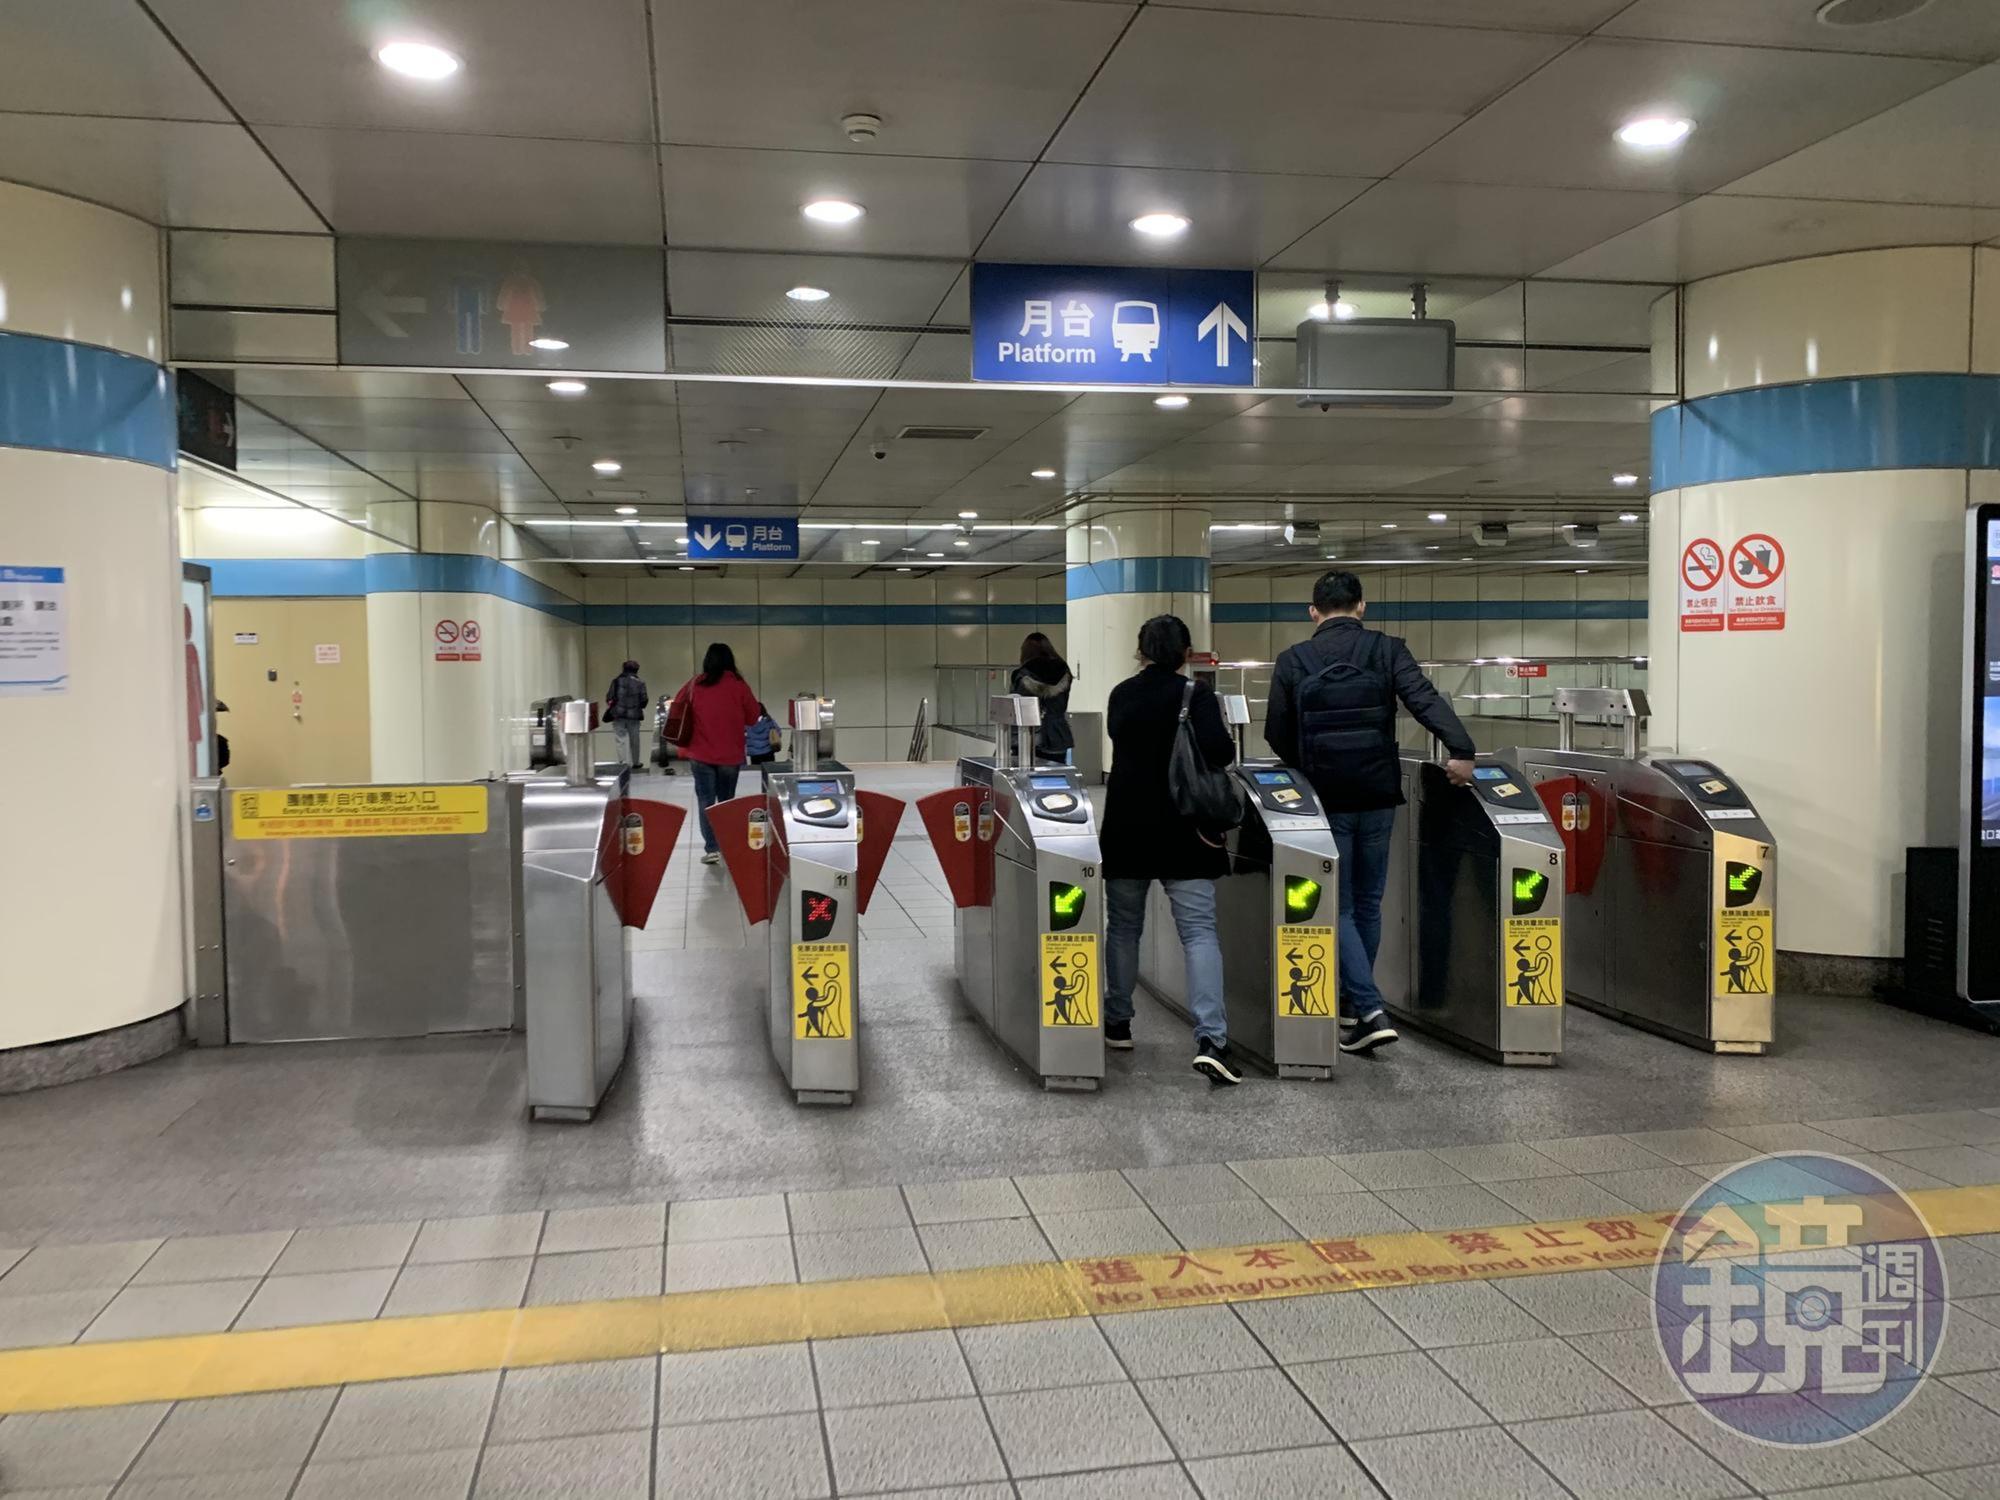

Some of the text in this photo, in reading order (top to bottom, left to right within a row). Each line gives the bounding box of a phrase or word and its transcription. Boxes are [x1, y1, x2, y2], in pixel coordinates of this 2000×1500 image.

[1019, 300, 1096, 339] 月台
[998, 342, 1097, 364] Platform
[752, 526, 783, 541] 月台
[752, 543, 791, 551] Platform
[1735, 595, 1777, 606] 禁止飲食
[1760, 846, 1770, 858] 7
[1549, 853, 1558, 865] 8
[1081, 867, 1095, 878] 10
[1322, 860, 1332, 873] 9
[836, 875, 848, 887] 11
[1080, 1241, 1376, 1286] 進入本區
[1096, 1290, 1143, 1305] No
[1151, 1266, 1405, 1301] Eating/Drinking
[1406, 1257, 1529, 1277] Beyond
[1531, 1255, 1583, 1267] the
